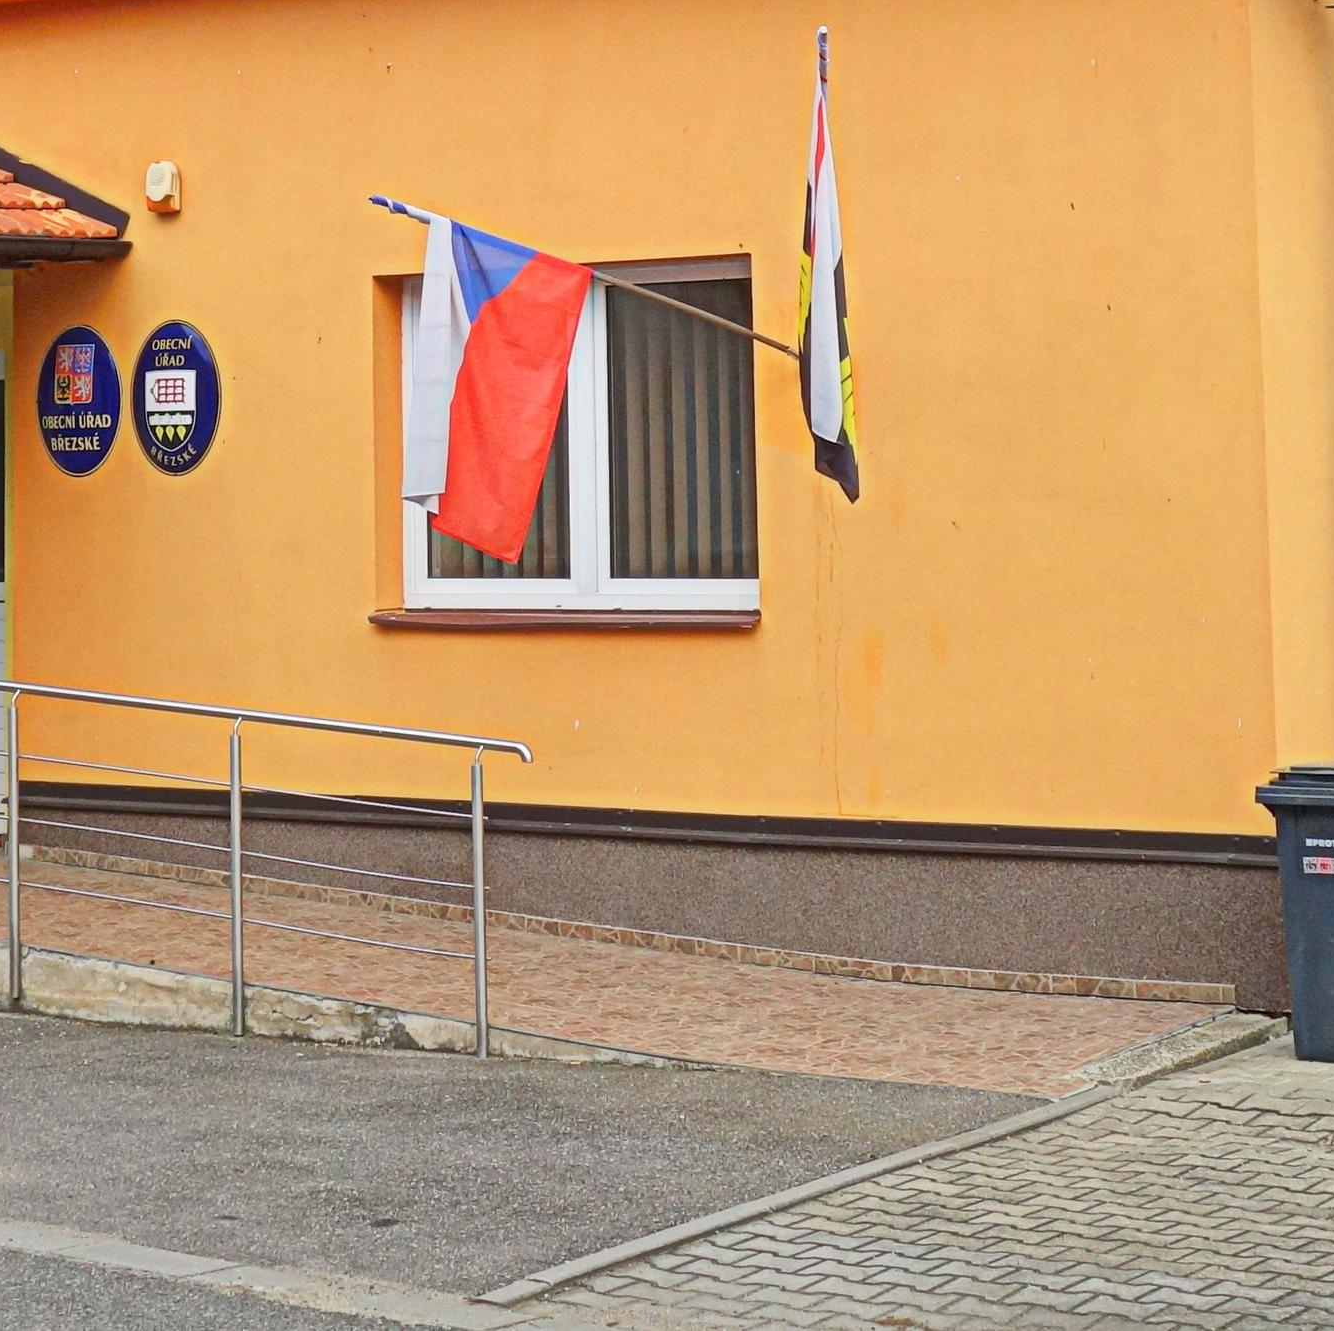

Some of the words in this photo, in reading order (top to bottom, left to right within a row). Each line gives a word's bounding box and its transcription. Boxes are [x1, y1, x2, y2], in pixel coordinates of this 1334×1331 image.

[152, 335, 193, 350] OBECNÍ
[155, 353, 185, 366] ÚŘAD
[42, 411, 75, 429] OBECNÍ
[78, 411, 112, 429] ÚŘAD
[50, 432, 101, 451] BŘEZSKÉ
[151, 443, 197, 467] BŘEZSKÉ
